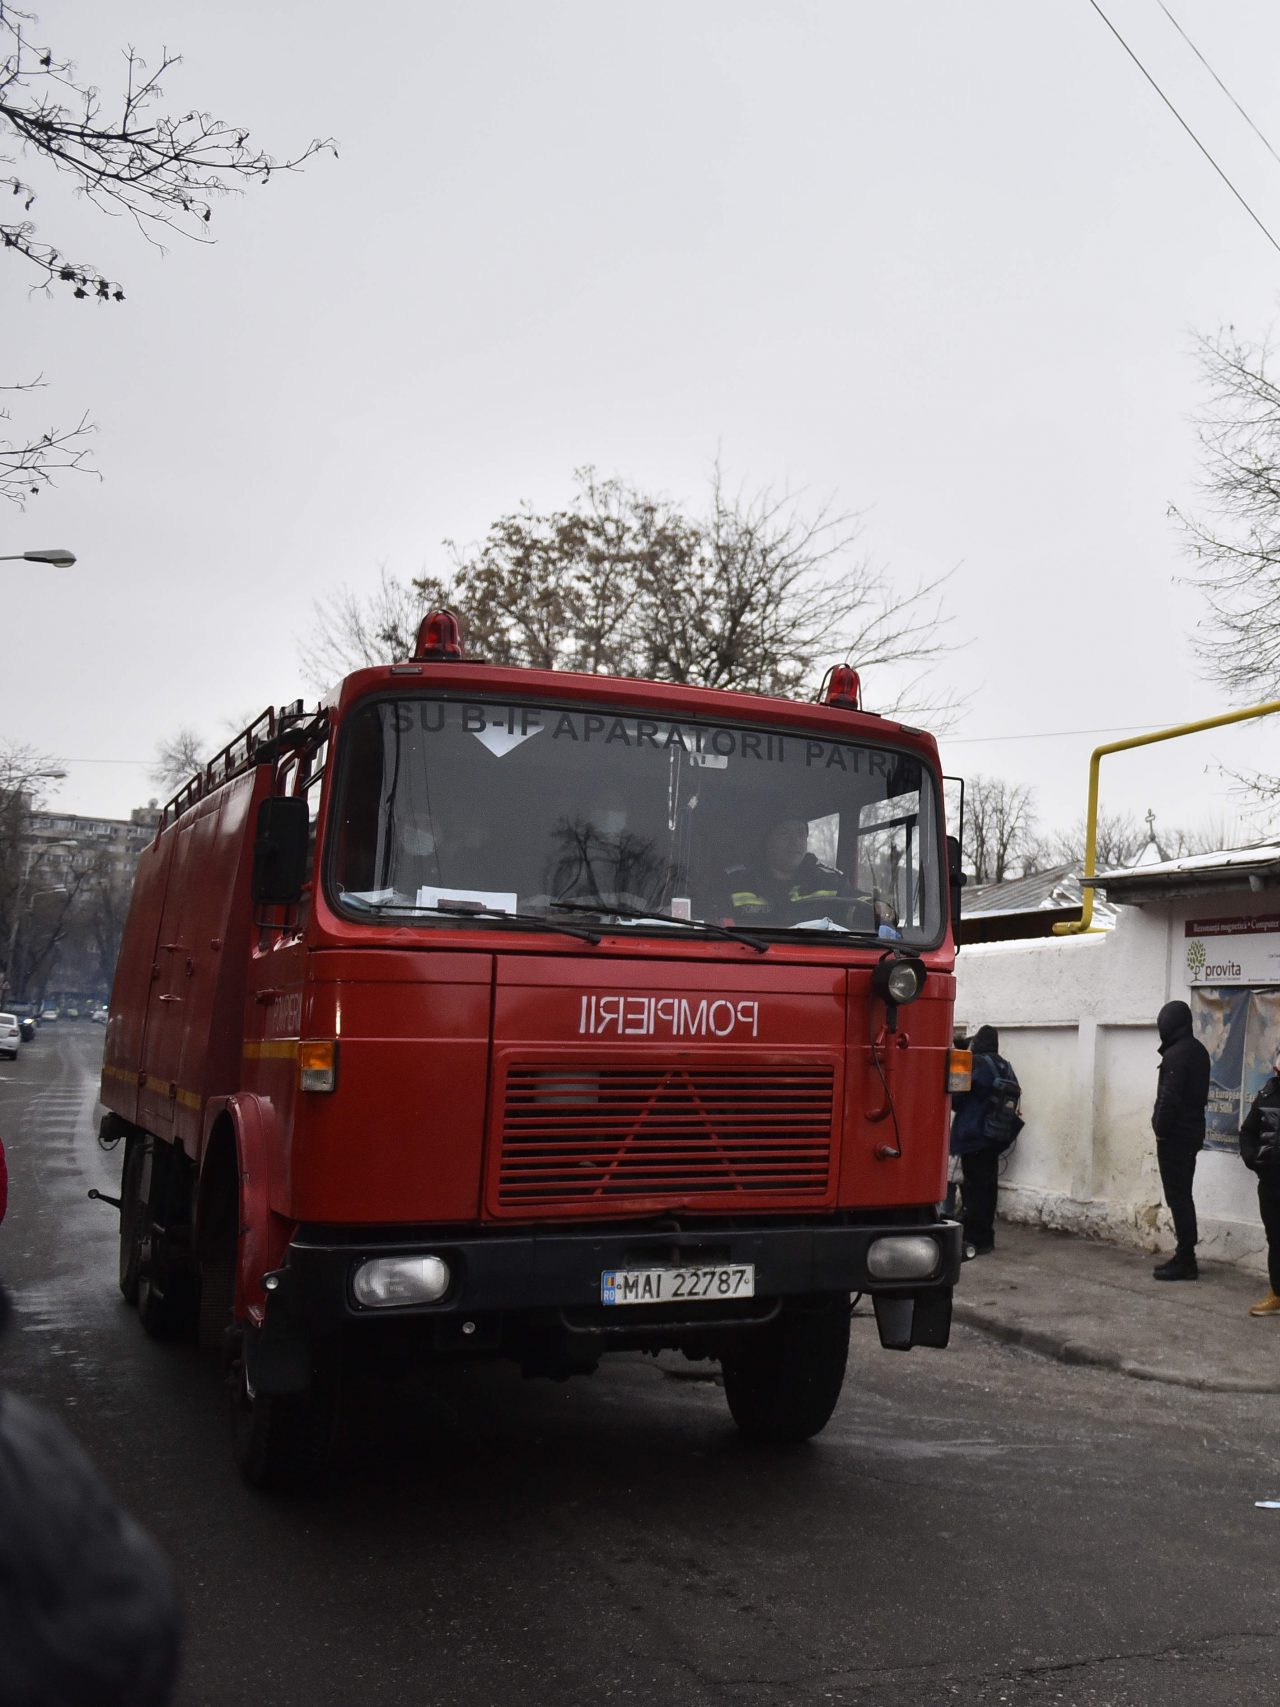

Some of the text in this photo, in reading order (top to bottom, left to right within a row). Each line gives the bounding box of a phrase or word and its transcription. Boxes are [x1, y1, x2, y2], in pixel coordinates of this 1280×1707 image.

[551, 712, 785, 763] APARATORII
[1205, 959, 1242, 980] provita
[604, 1290, 615, 1300] RO
[622, 1269, 747, 1300] MAI 22787
